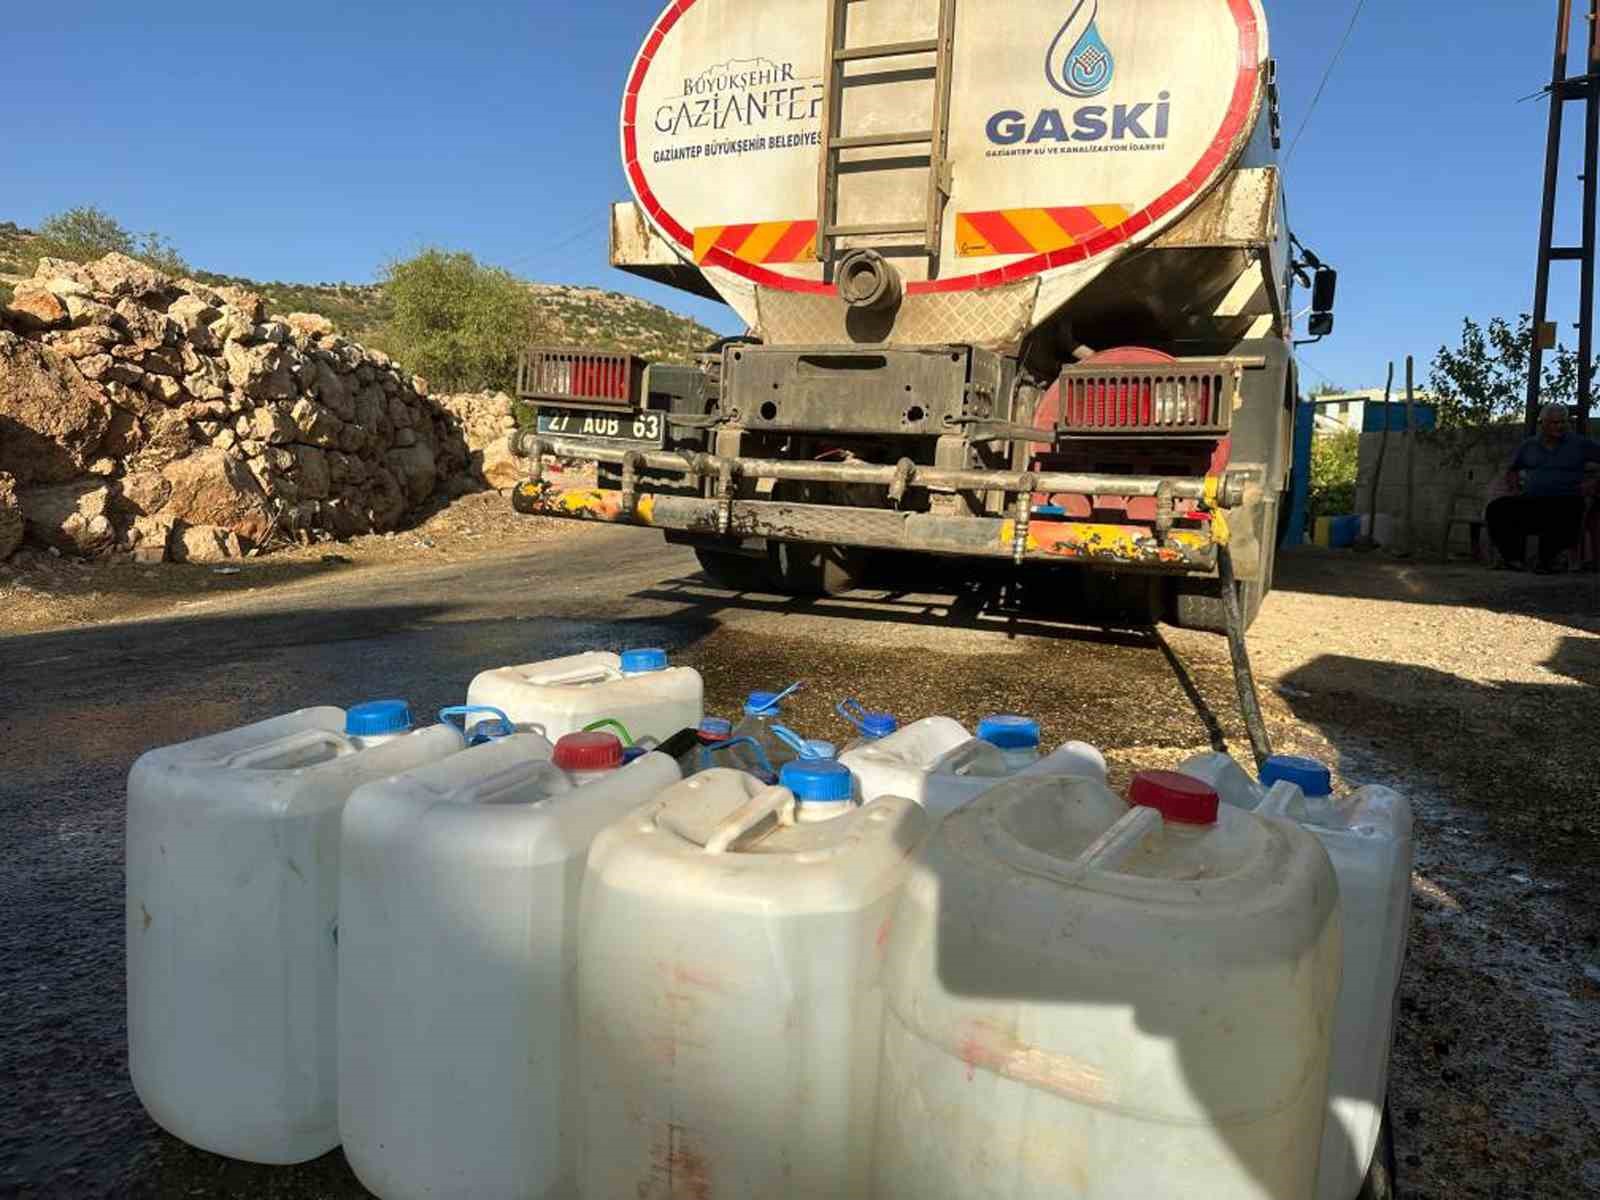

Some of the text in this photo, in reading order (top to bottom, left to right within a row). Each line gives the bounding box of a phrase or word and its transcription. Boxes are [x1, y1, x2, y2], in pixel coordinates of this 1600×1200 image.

[985, 90, 1170, 145] GASKİ
[653, 130, 822, 163] GAZİANTEP BÜYÜKŞEHİR BELEDİYES
[1047, 146, 1058, 155] VE
[632, 415, 659, 439] 63
